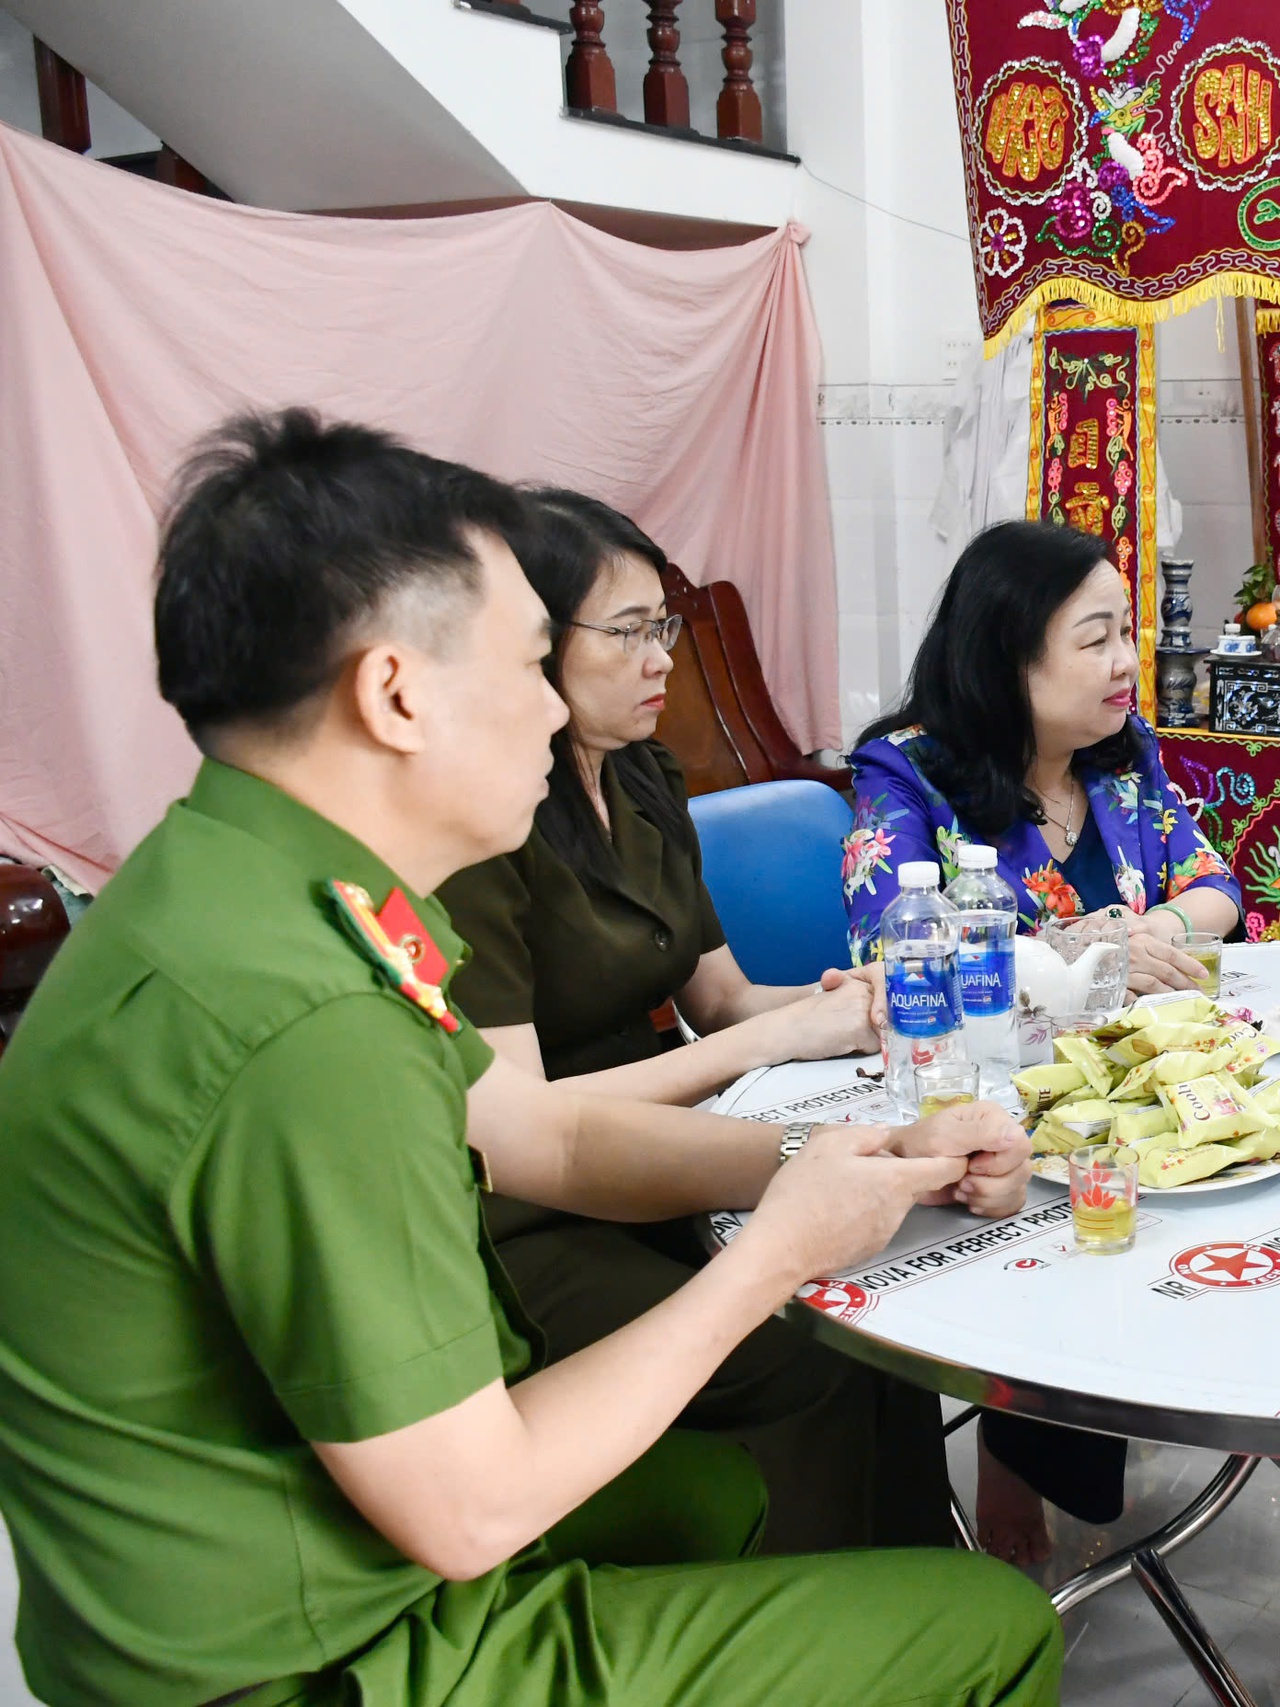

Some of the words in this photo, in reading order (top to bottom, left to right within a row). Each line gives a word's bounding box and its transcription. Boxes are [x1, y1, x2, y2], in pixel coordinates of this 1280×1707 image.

[1193, 63, 1272, 168] SANH
[960, 972, 1001, 988] UAFINA
[891, 992, 947, 1010] AQUAFINA
[785, 1081, 885, 1114] PROTECTION
[848, 1266, 916, 1292] NOVA
[905, 1251, 957, 1272] FOR
[946, 1221, 1031, 1257] PERFECT
[1243, 1244, 1261, 1252] VA
[1151, 1280, 1198, 1299] NR
